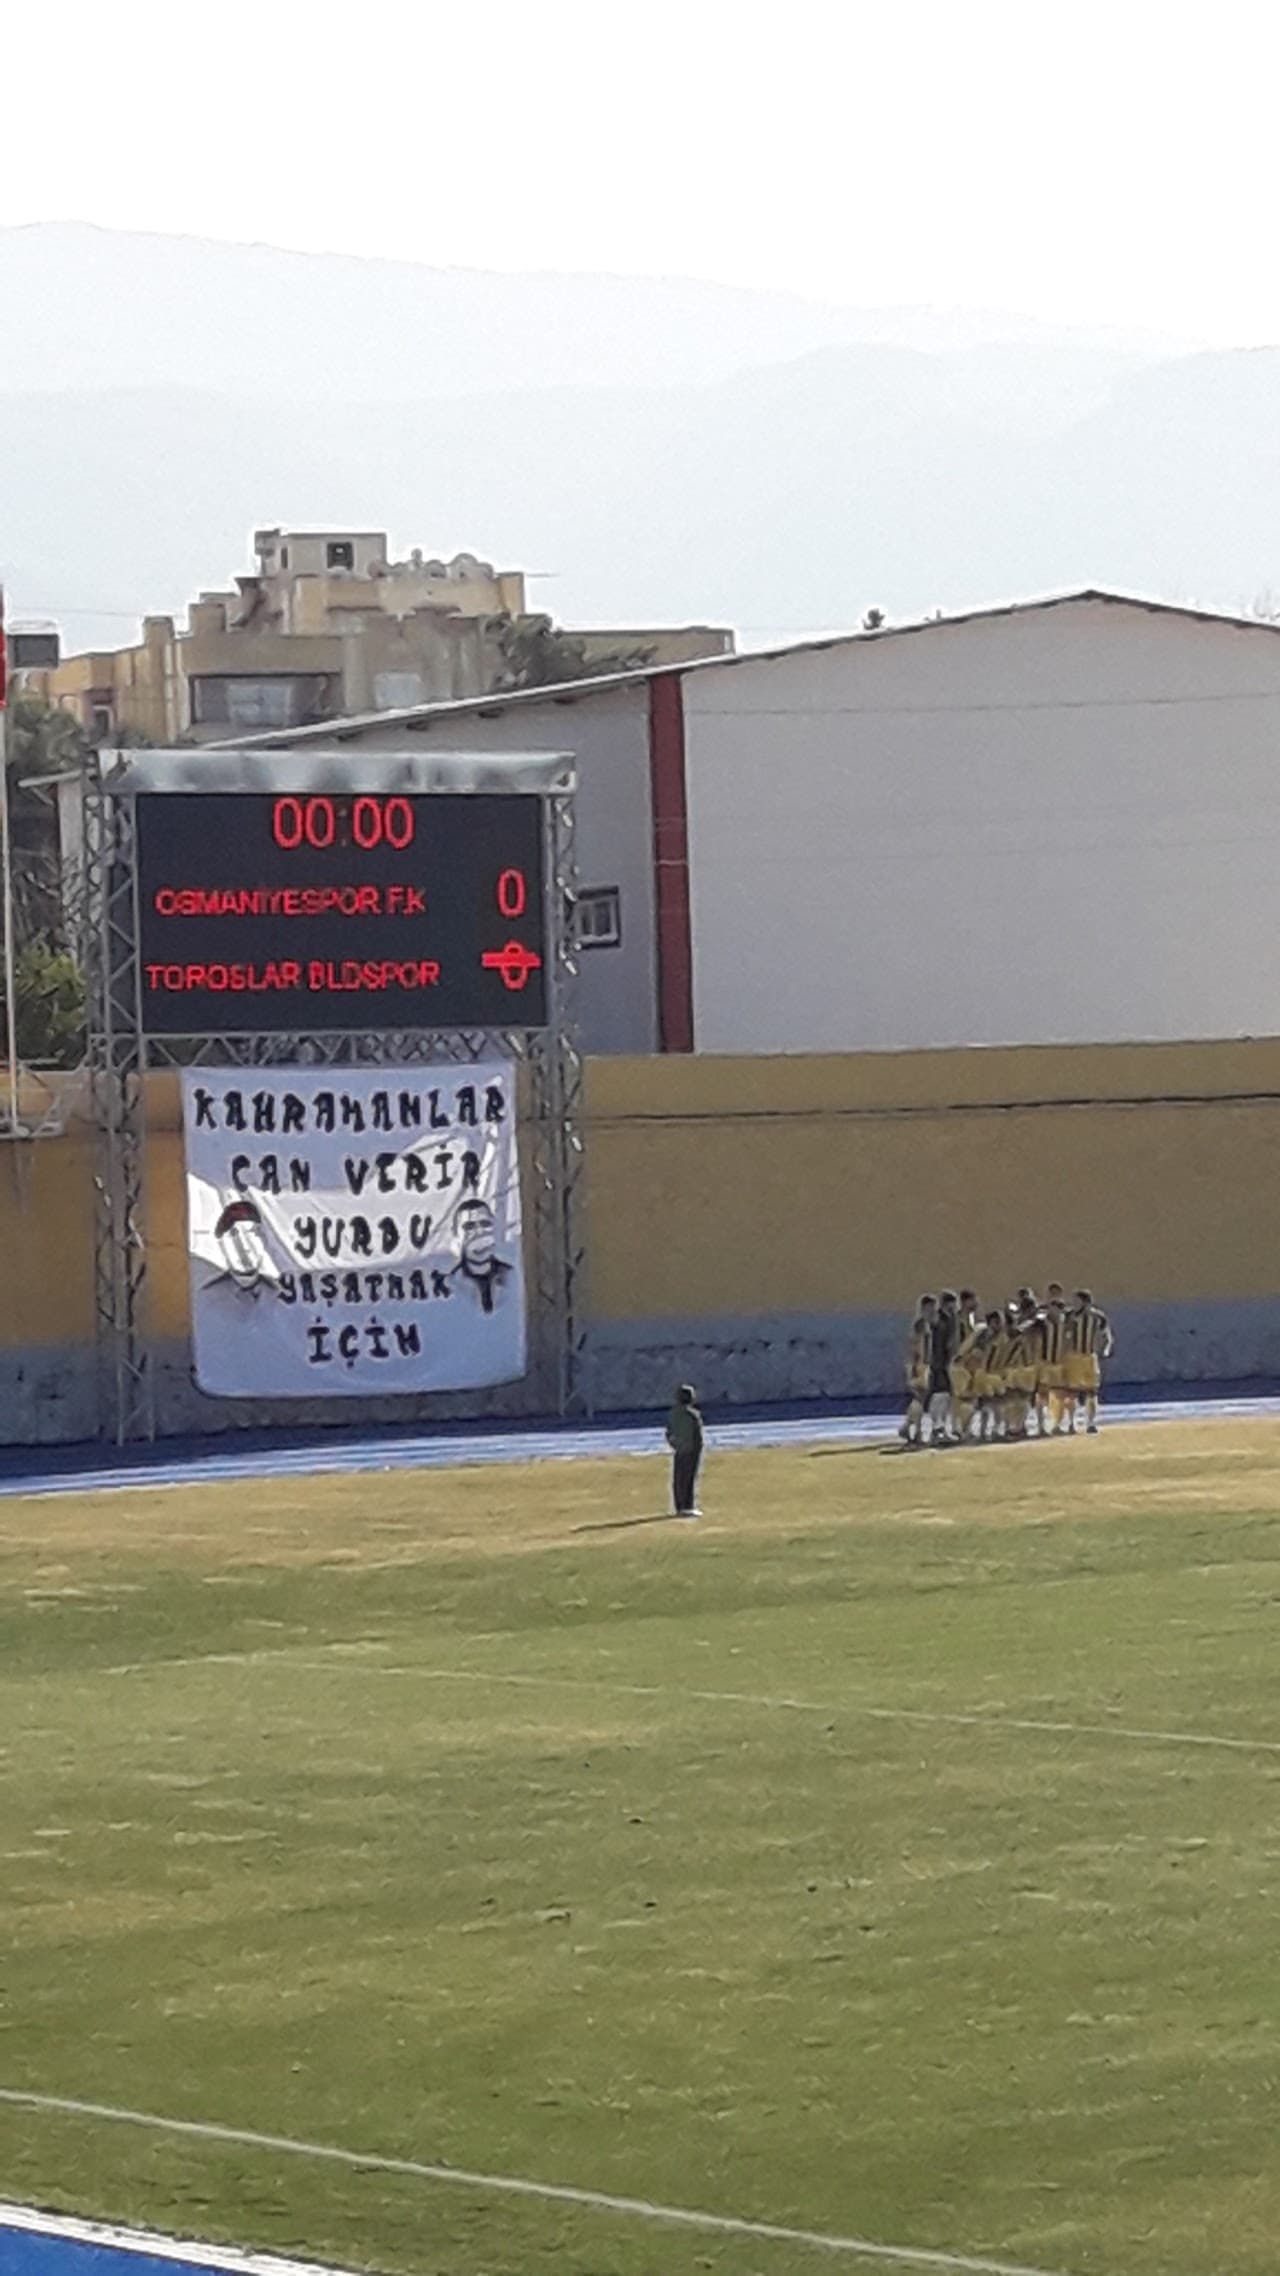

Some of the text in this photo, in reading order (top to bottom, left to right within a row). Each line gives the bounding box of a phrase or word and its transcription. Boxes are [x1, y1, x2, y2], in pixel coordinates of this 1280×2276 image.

[273, 797, 414, 849] 00:00
[497, 868, 525, 917] 0
[146, 961, 299, 991] TOROSLAR
[194, 1087, 504, 1132] KAHRAMANLAR
[232, 1154, 310, 1194] CAN
[295, 1214, 432, 1257] YURDU
[277, 1269, 451, 1307] YAŞATMAK
[307, 1316, 420, 1367] İÇİN
